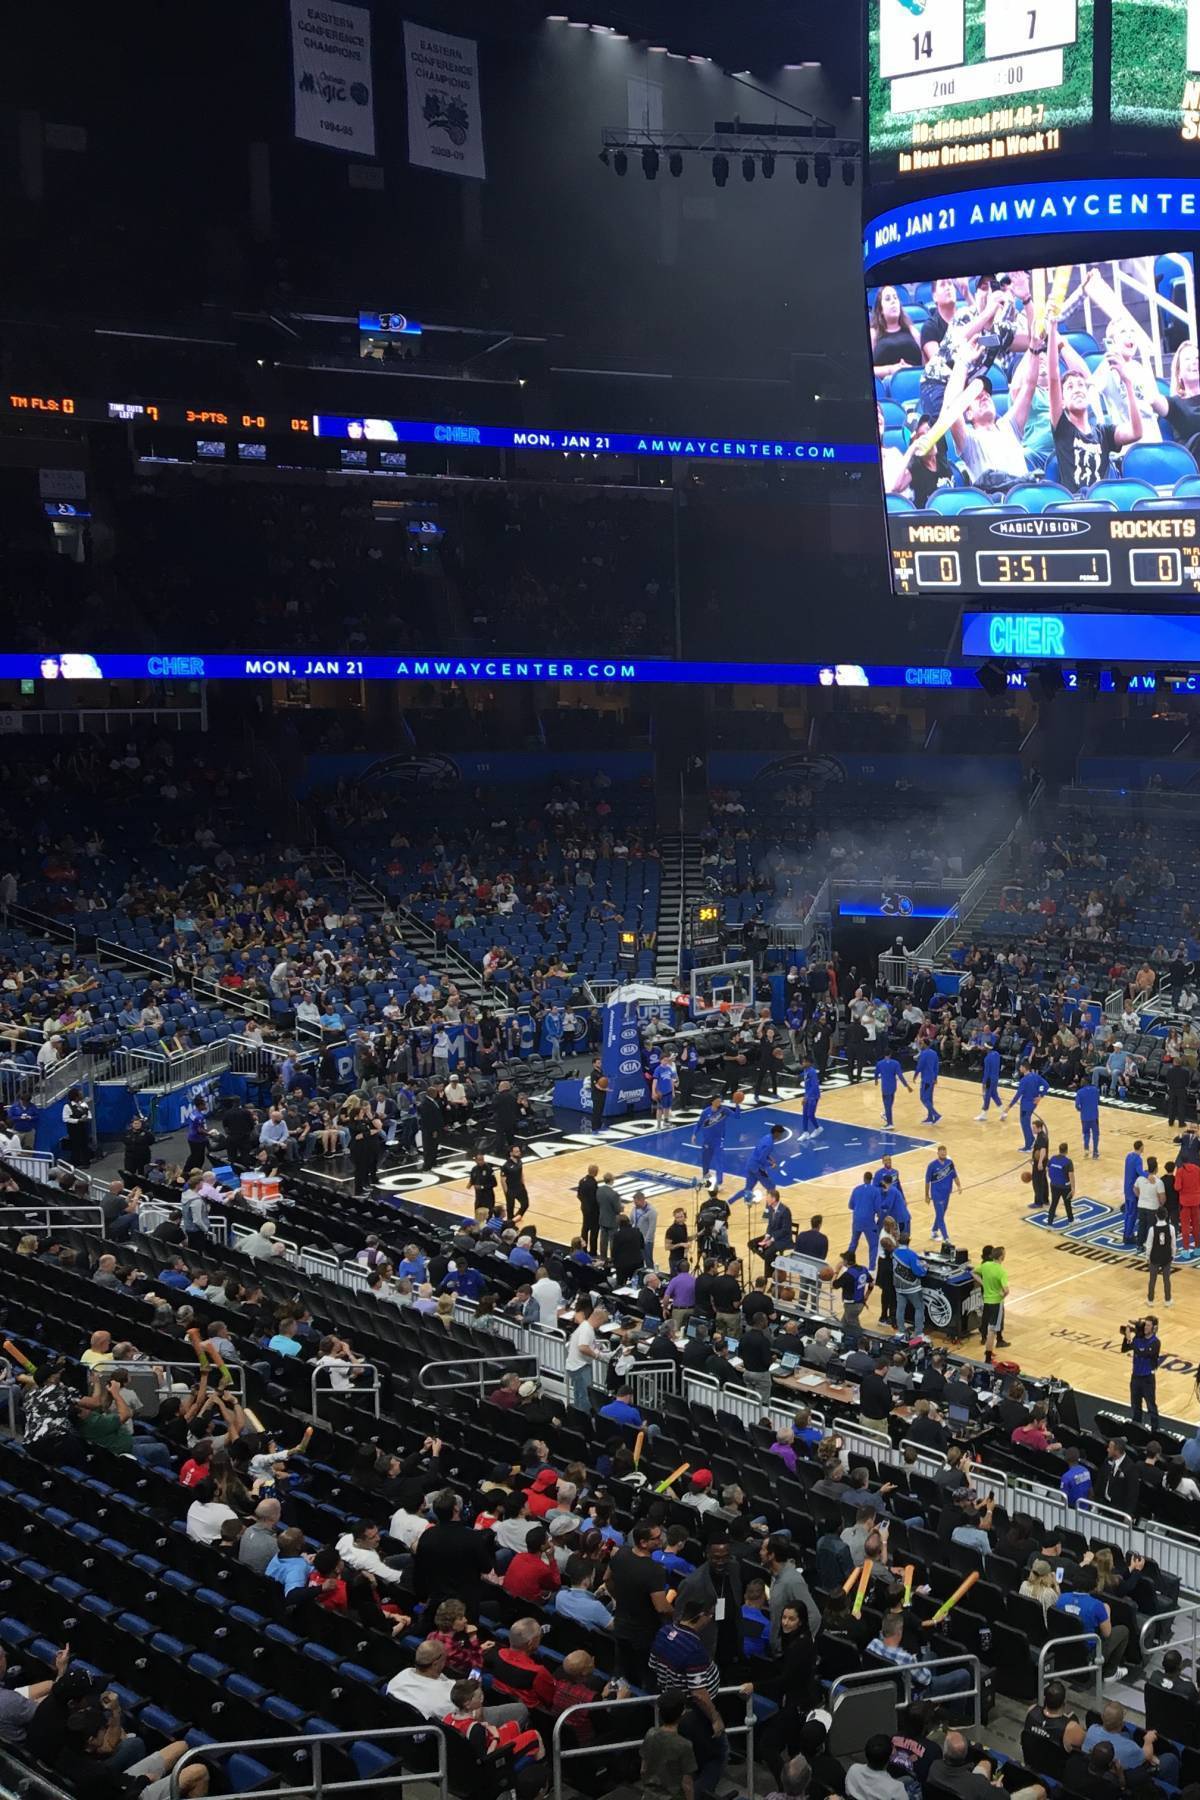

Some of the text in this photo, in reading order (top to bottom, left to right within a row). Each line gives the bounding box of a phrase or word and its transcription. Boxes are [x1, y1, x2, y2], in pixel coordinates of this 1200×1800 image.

[307, 8, 354, 29] EASTERN
[1027, 9, 1037, 40] 7
[298, 20, 365, 47] CONFERENCE
[304, 38, 361, 61] CHAMPIONS
[420, 40, 463, 60] EASTERN
[912, 30, 934, 61] 14
[411, 52, 473, 76] CONFERENCE
[415, 67, 471, 90] CHAMPIONS
[932, 79, 956, 97] 2nd
[913, 149, 940, 170] New
[941, 141, 990, 165] Orleans
[1007, 132, 1044, 155] Week
[1046, 129, 1059, 150] 11
[875, 222, 901, 248] MON,
[905, 213, 933, 238] JAN
[938, 208, 955, 229] 21
[10, 395, 74, 414] TM FLS: 0
[146, 406, 158, 421] 7
[186, 410, 309, 432] 3-PTS: 0-0 0%
[434, 425, 480, 443] CHER
[514, 433, 610, 449] MON, JAN 21
[638, 440, 836, 459] AMWAYCENTER.COM
[908, 525, 961, 543] MAGIC
[1110, 519, 1196, 539] ROCKETS
[940, 557, 953, 581] 0
[998, 556, 1048, 582] 3:51
[1158, 555, 1172, 581] 0
[989, 615, 1065, 656] CHER
[148, 656, 205, 676] CHER
[245, 660, 364, 676] MON, JAN 21
[397, 660, 636, 679] AMWAYCENTER.COM
[905, 667, 952, 685] CHER
